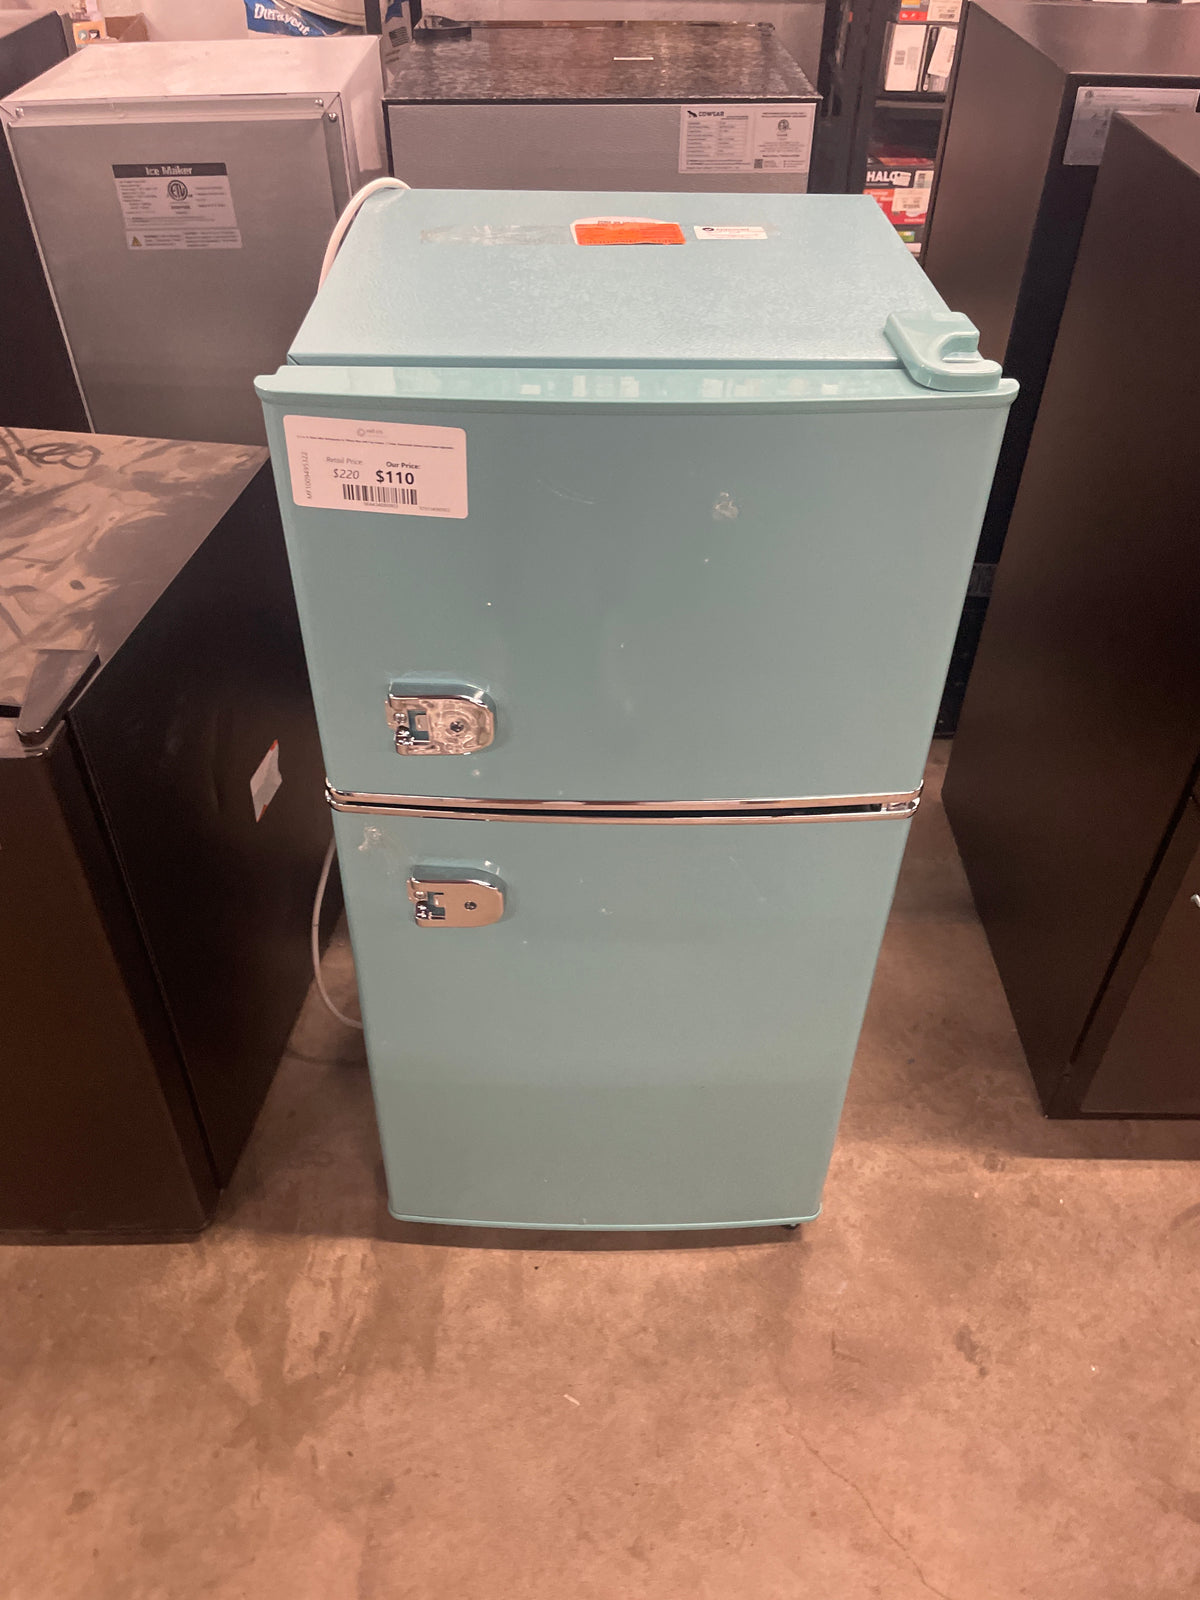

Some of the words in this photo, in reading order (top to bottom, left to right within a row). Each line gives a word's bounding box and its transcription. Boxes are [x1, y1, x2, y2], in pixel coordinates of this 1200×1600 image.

[145, 167, 160, 175] Ice
[161, 165, 193, 175] Maker
[326, 456, 345, 464] Retail
[333, 468, 360, 480] $220
[375, 469, 414, 485] $110
